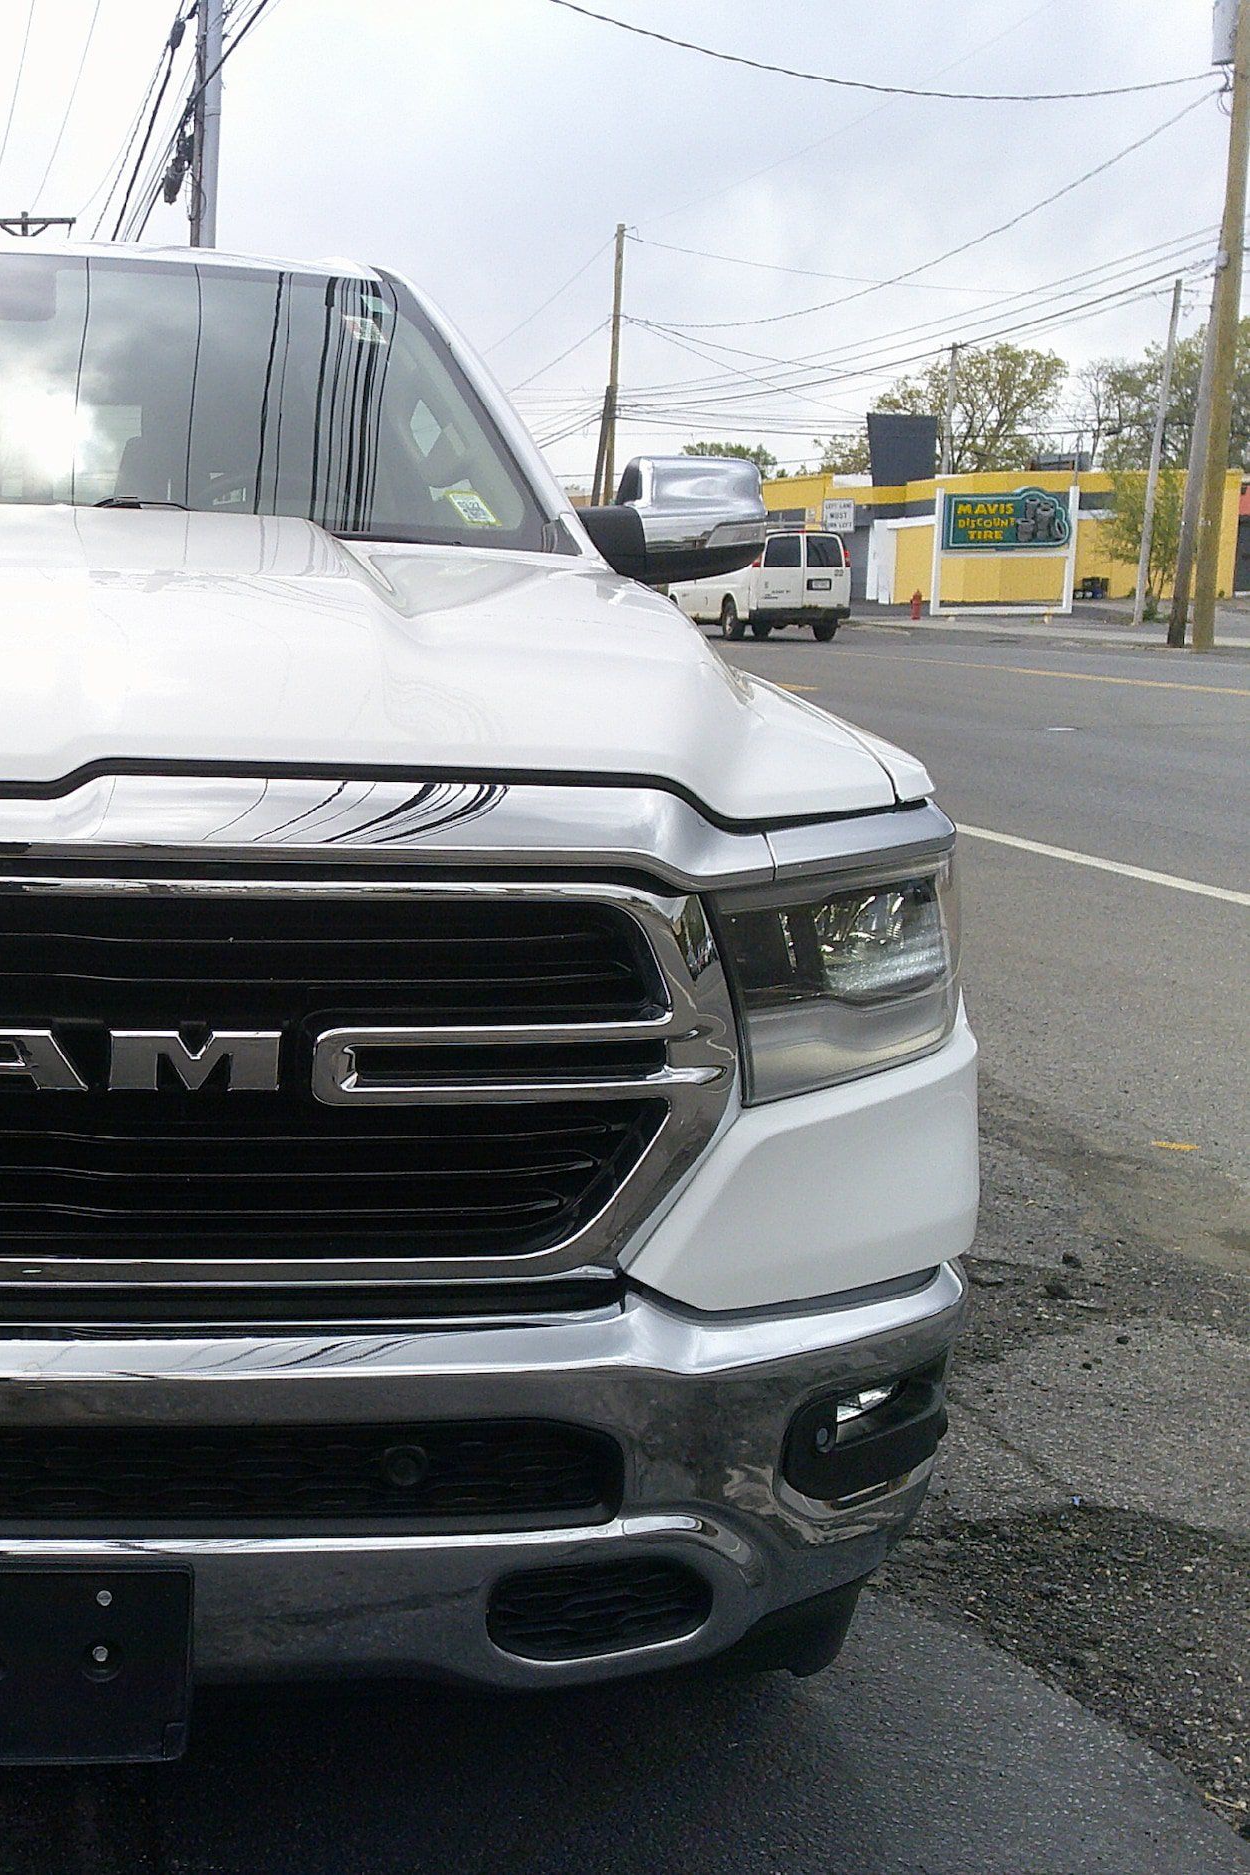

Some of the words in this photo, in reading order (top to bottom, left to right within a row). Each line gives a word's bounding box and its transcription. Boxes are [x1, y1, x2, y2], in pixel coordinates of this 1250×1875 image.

[957, 503, 1014, 515] MAVIS
[958, 517, 1016, 529] DISCOUNT
[968, 530, 1004, 541] TIRE
